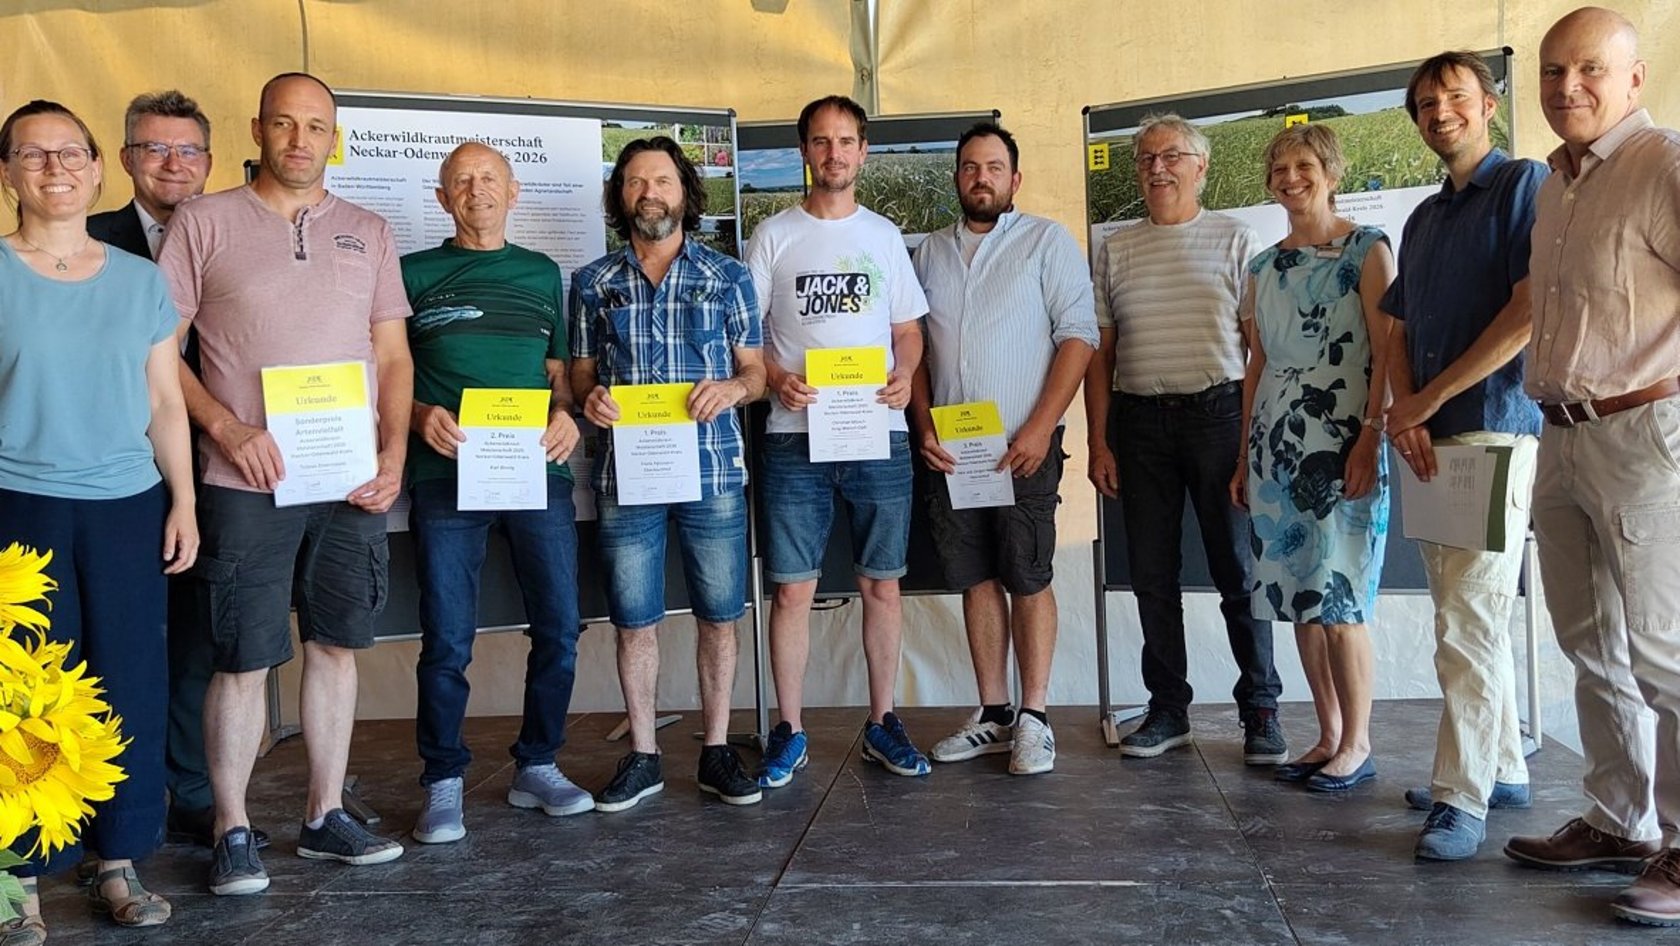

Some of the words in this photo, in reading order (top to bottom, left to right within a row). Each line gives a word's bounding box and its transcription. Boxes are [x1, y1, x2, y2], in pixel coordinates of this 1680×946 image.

[349, 129, 543, 148] Ackerwildkrautmeisterschaft
[349, 145, 450, 160] Neckar-Odenw
[514, 151, 548, 164] 2026
[796, 275, 851, 297] JACK
[853, 275, 870, 296] &
[799, 294, 862, 317] JONES
[831, 372, 863, 380] Urkunde
[296, 394, 338, 406] Urkunde
[487, 413, 523, 422] Urkunde
[637, 410, 672, 419] Urkunde
[955, 425, 983, 433] Urkunde
[490, 431, 497, 439] 2.
[498, 431, 515, 439] Preis
